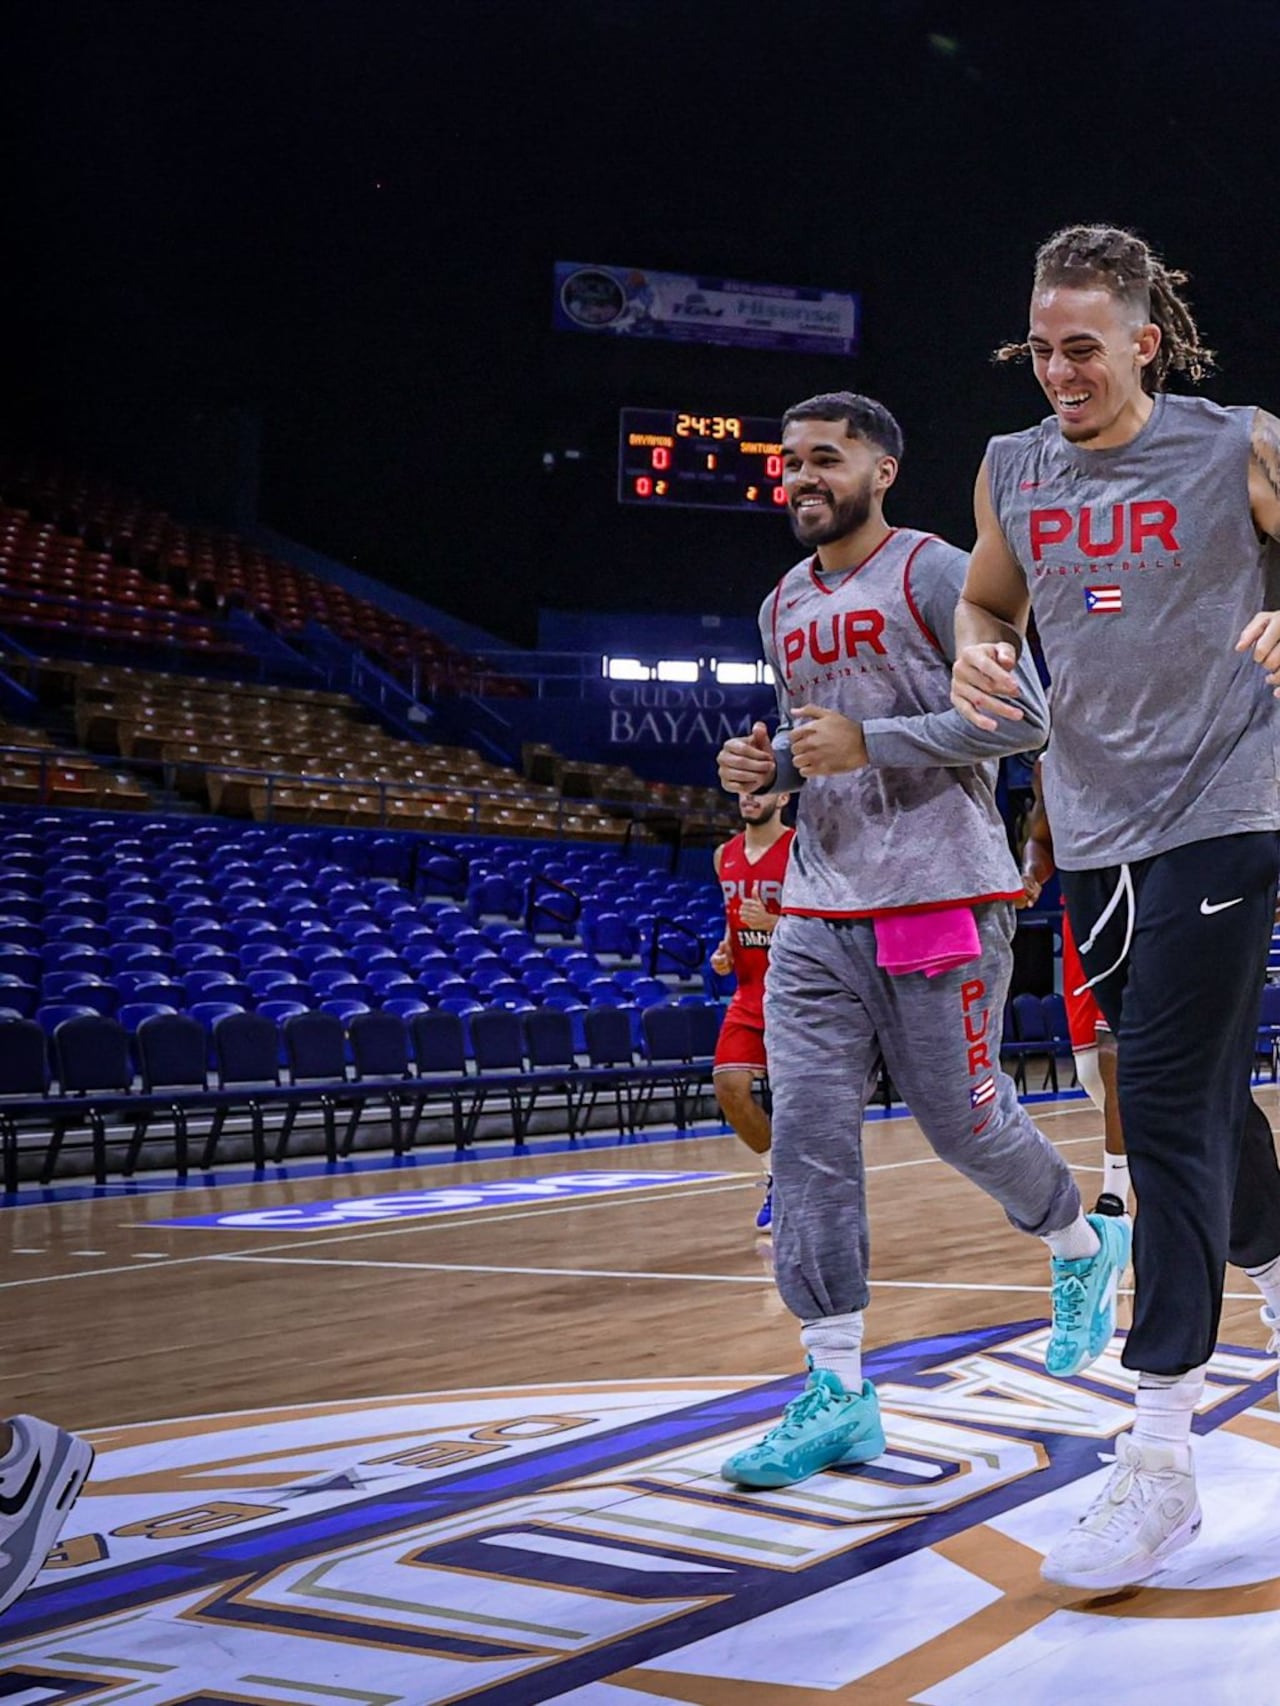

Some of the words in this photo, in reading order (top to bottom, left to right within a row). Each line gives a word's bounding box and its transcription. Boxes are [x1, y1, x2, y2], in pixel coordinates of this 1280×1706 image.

[676, 413, 741, 439] 24:39
[652, 447, 669, 469] 0
[706, 453, 716, 470] 1
[767, 456, 783, 477] 0
[636, 477, 651, 495] 0
[655, 480, 667, 495] 2
[746, 486, 757, 500] 2
[773, 486, 787, 503] 0
[1030, 498, 1181, 561] PUR
[783, 608, 888, 680] PUR
[960, 978, 993, 1077] PUR
